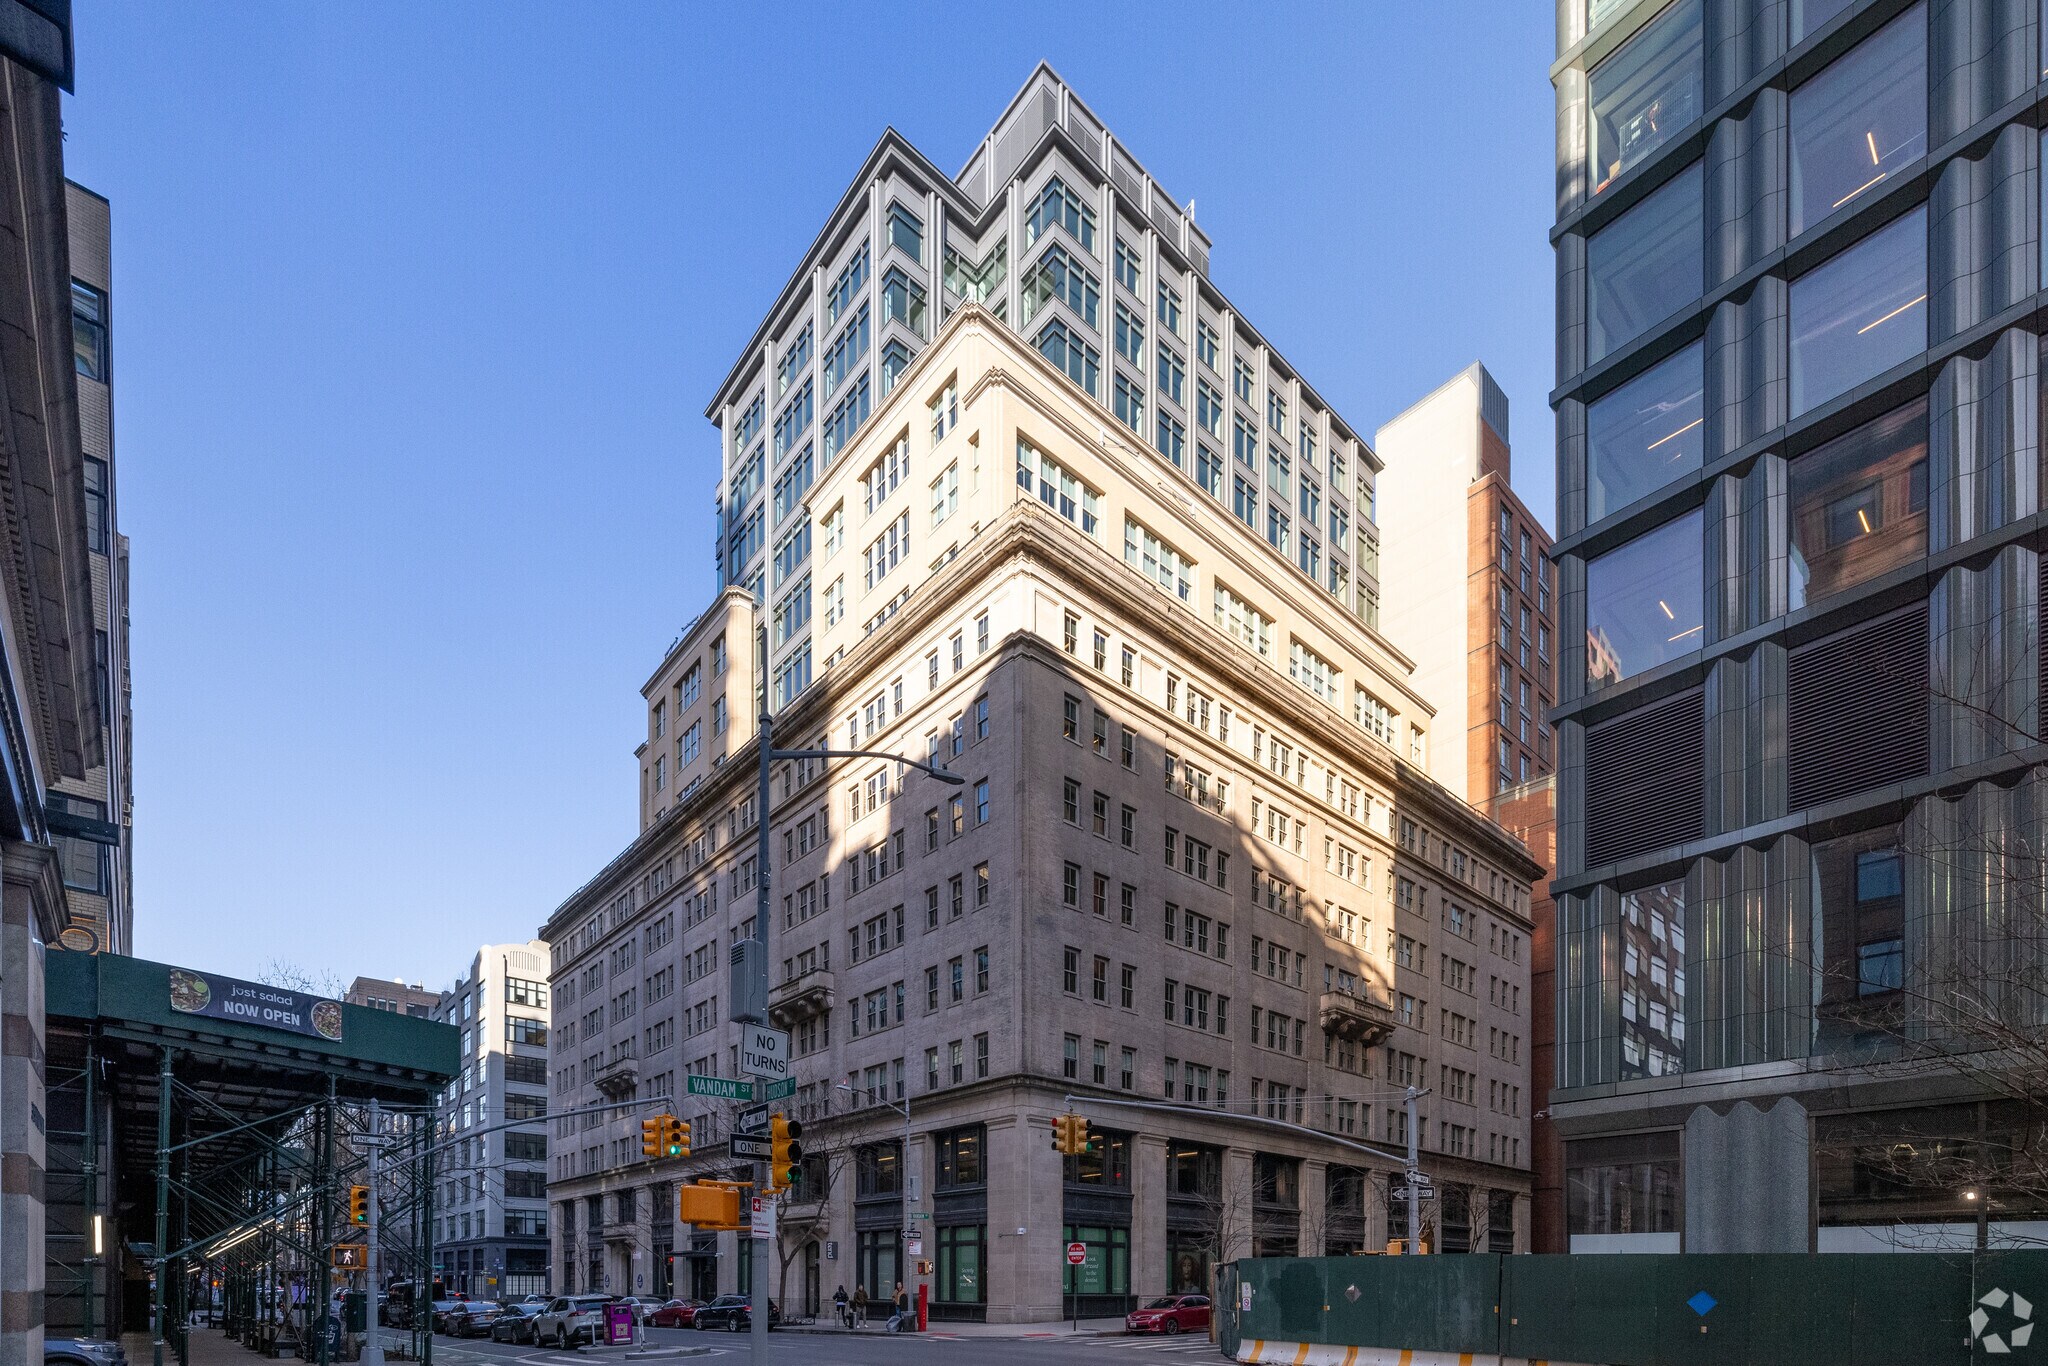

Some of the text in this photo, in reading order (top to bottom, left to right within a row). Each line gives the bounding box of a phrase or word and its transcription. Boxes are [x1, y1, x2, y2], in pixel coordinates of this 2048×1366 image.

[231, 985, 293, 1006] just salad
[224, 1001, 300, 1026] NOW OPEN
[756, 1034, 775, 1051] NO
[745, 1052, 785, 1073] TURNS
[693, 1078, 736, 1097] VANDAM
[767, 1082, 788, 1100] HUDSON
[354, 1135, 369, 1143] ONE
[740, 1142, 760, 1153] ONE
